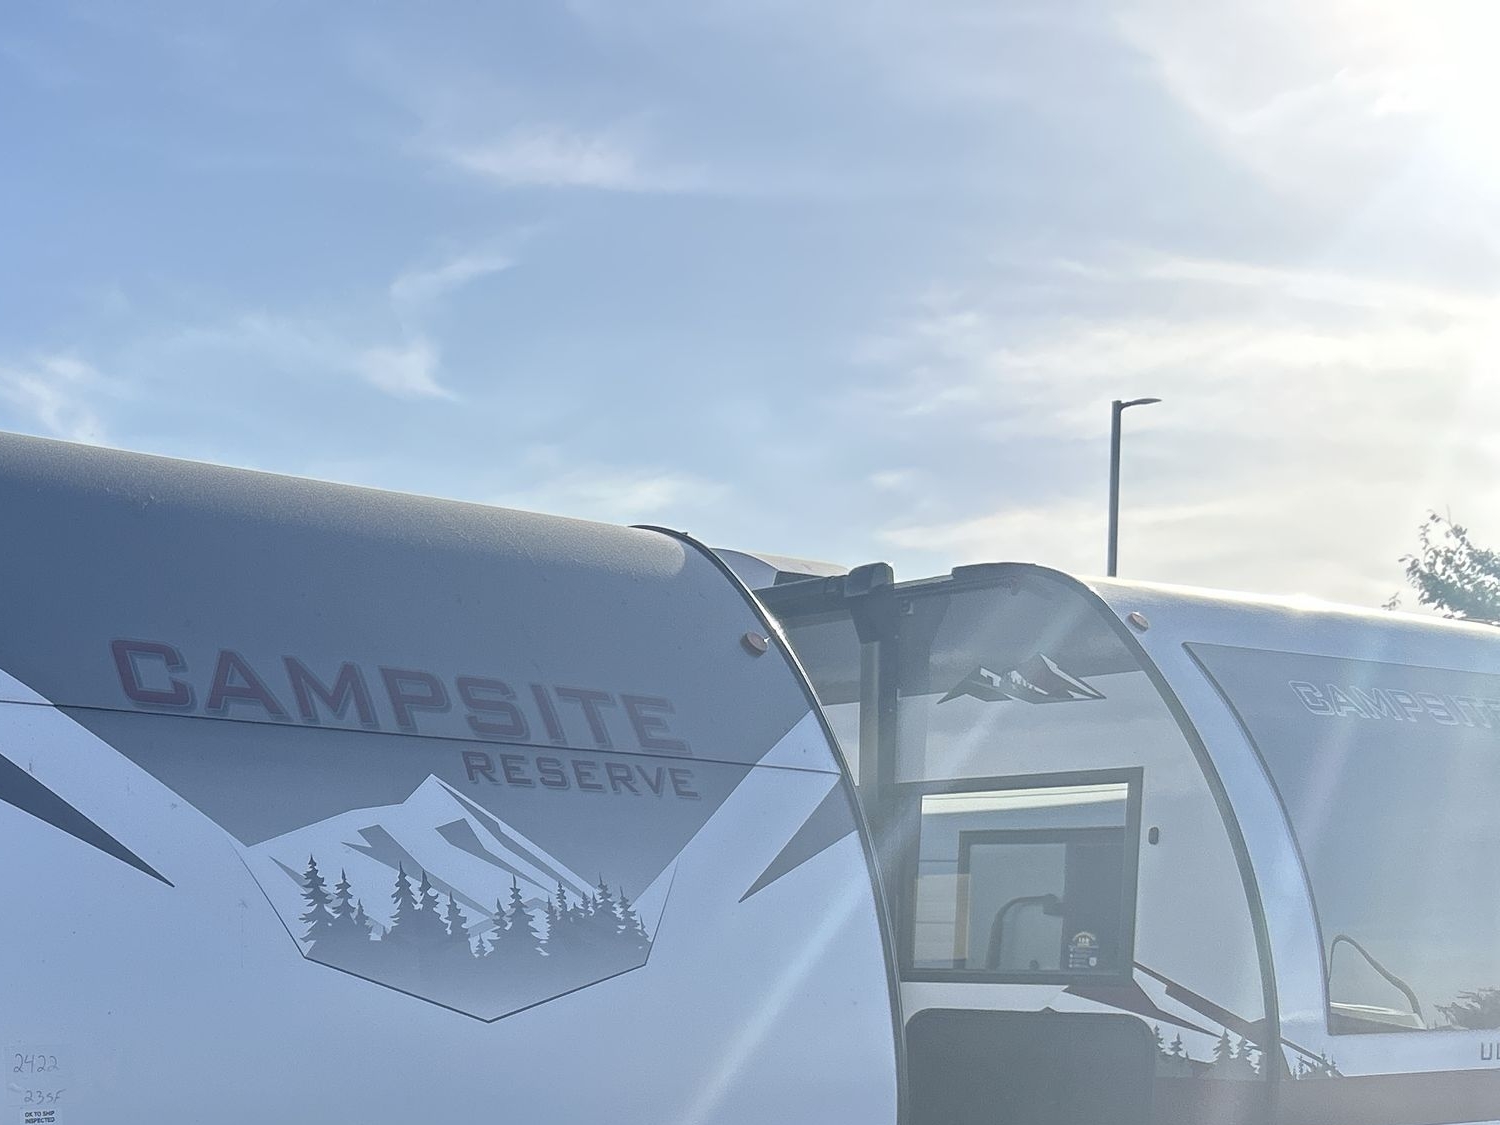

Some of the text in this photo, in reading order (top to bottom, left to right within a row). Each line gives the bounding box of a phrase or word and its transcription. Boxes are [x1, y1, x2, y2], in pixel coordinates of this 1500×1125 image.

[109, 639, 693, 756] CAMPSITE
[462, 750, 702, 799] RESERVE
[13, 1053, 59, 1073] 2422
